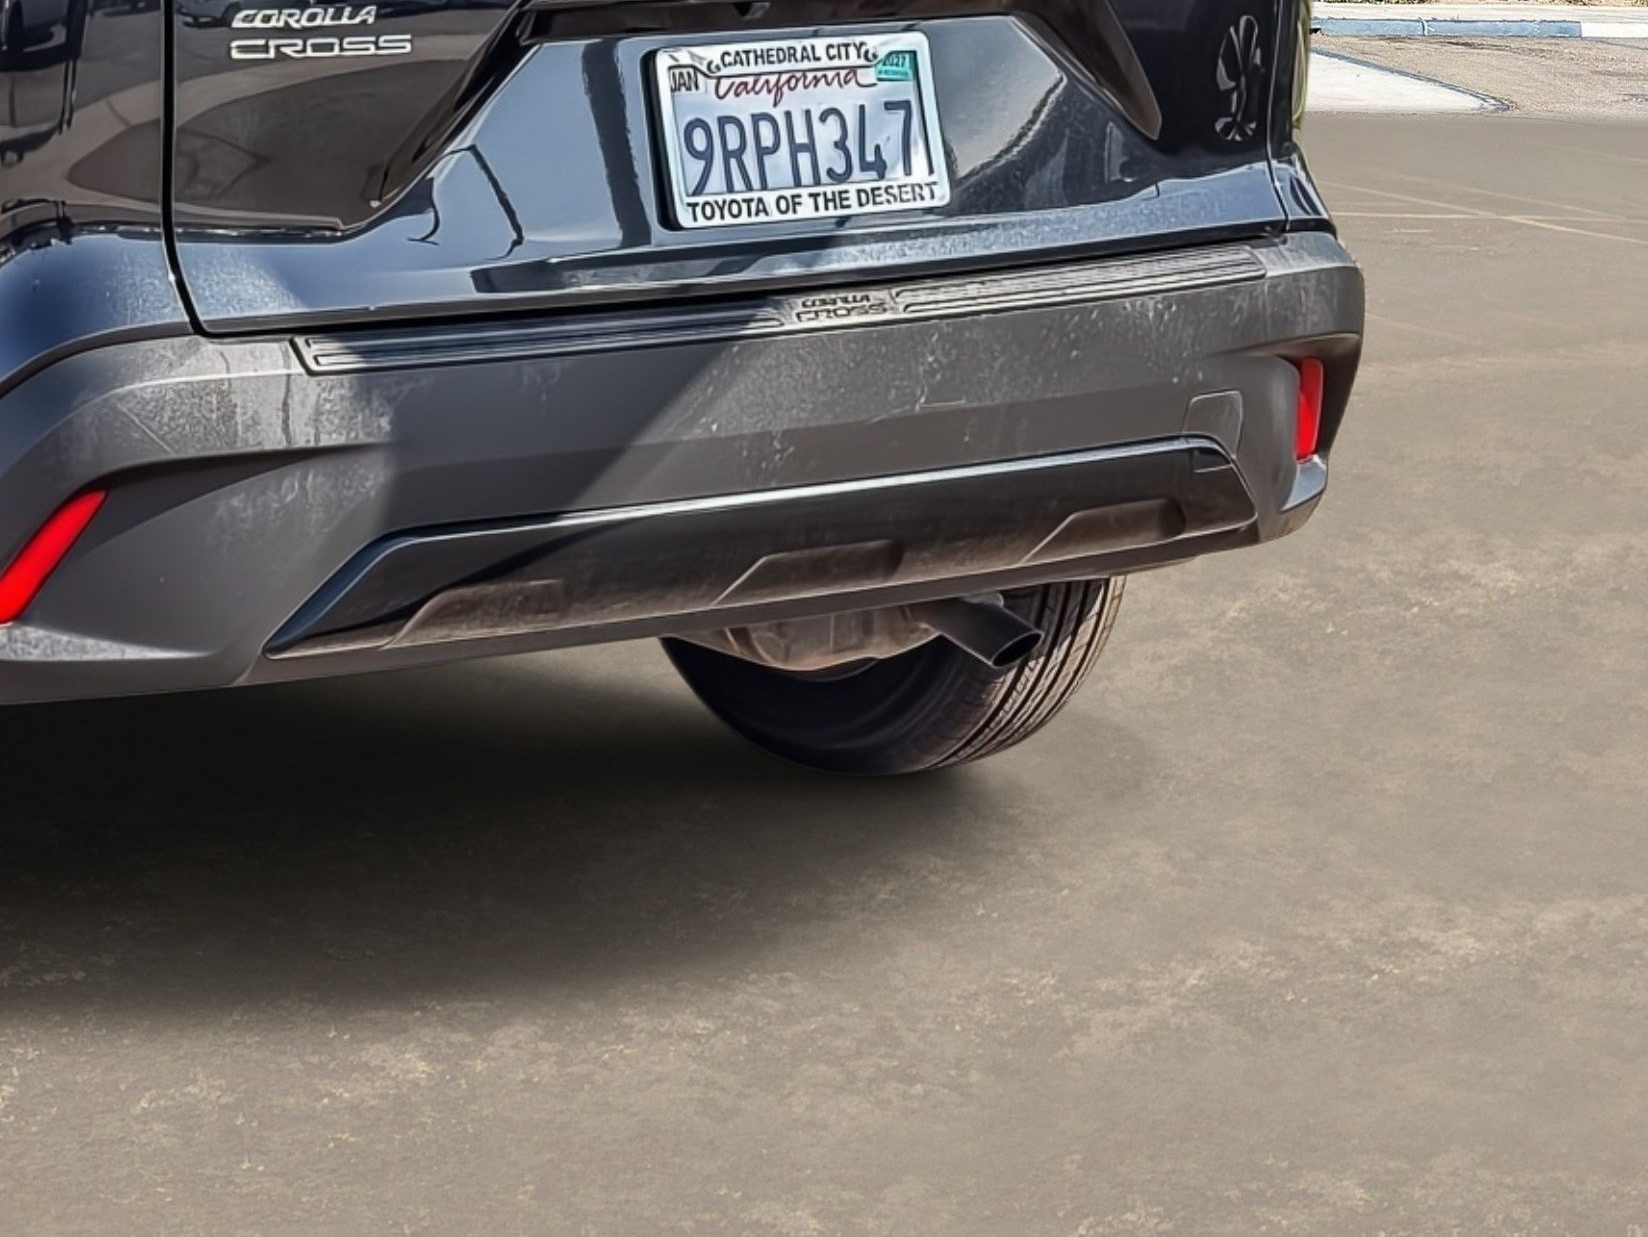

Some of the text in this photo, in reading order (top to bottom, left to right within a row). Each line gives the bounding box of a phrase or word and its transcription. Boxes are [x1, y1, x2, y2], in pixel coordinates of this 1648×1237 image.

[231, 5, 377, 30] COROLLA
[229, 33, 412, 60] CROSS
[721, 42, 864, 67] CATHEDRAL CITY
[669, 71, 699, 93] JAN
[714, 68, 877, 107] California
[683, 100, 912, 196] 9RPH347
[686, 182, 939, 223] TOYOTA OF THE DESERT
